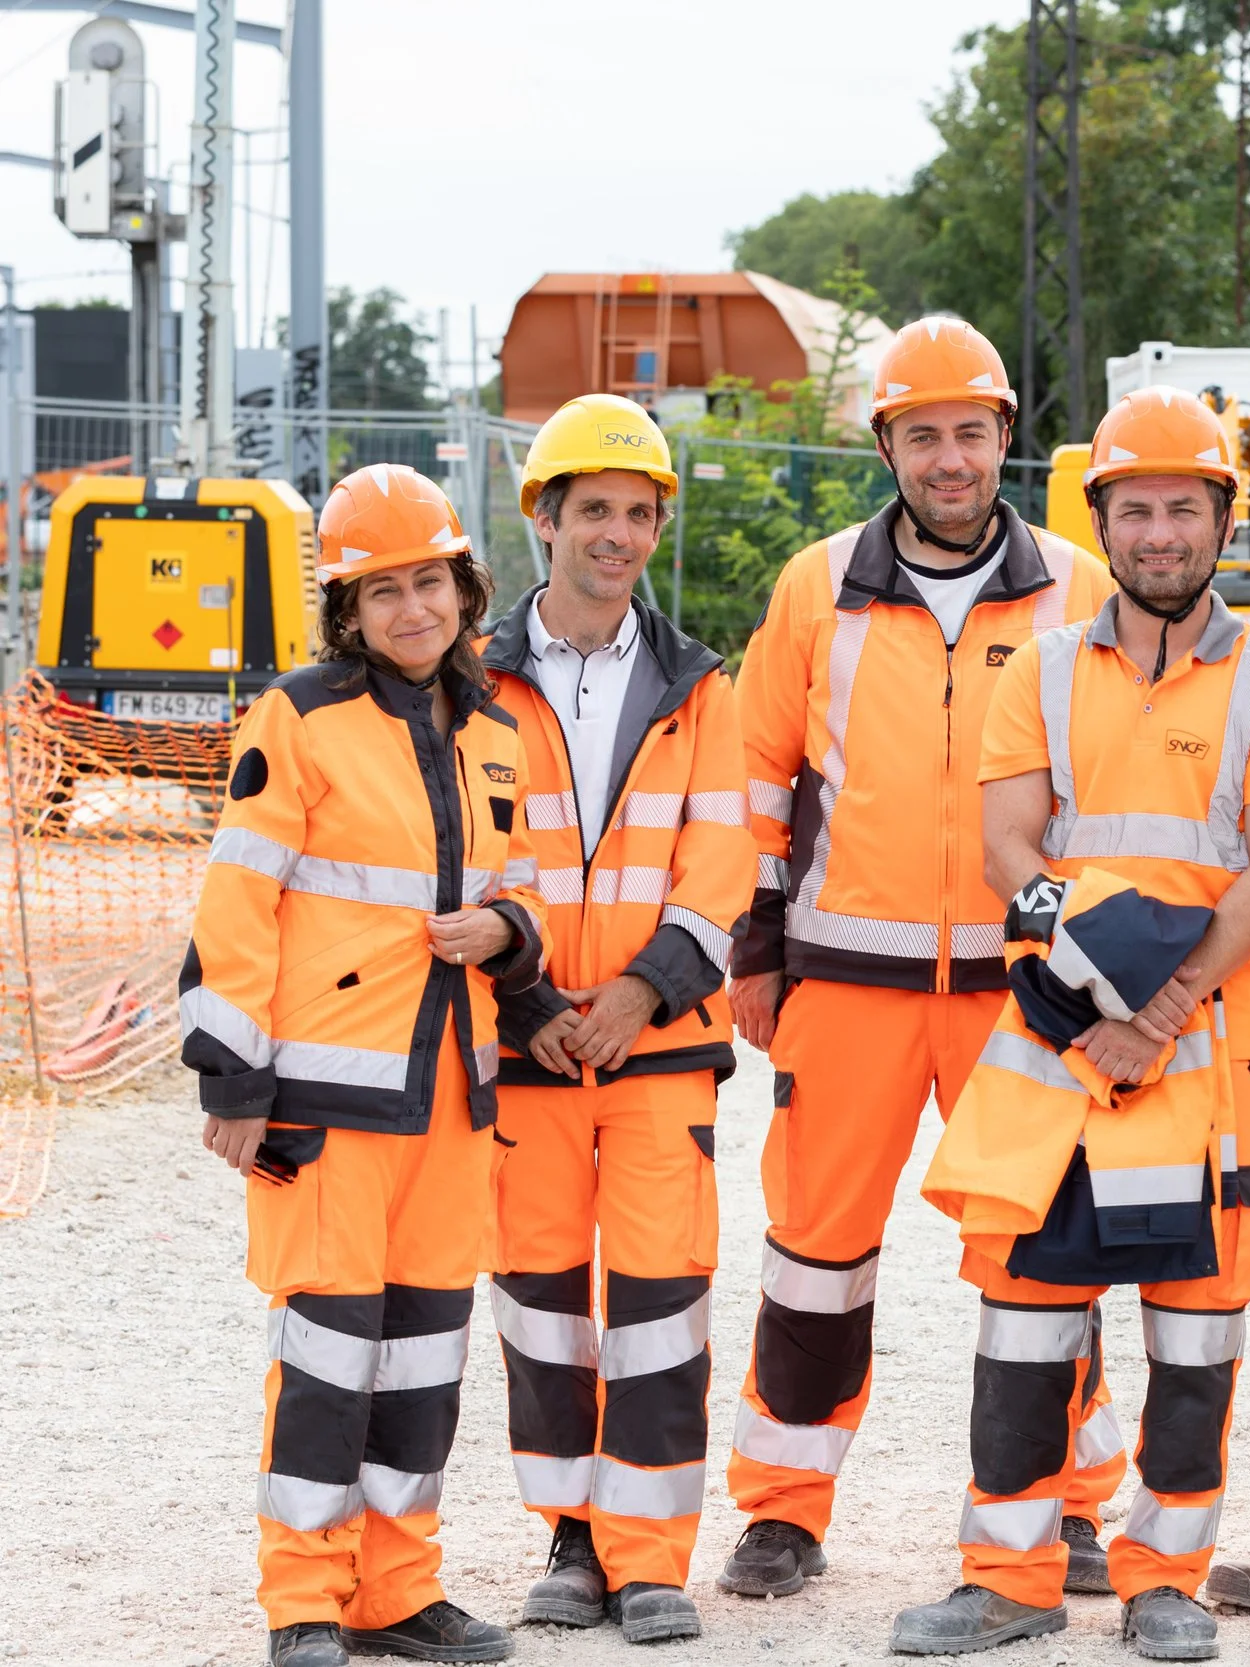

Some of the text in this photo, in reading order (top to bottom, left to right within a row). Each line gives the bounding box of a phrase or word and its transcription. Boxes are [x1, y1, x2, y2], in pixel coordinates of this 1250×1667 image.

[603, 432, 649, 448] SNCF
[1167, 738, 1207, 755] SNCF
[489, 769, 516, 782] SNCF
